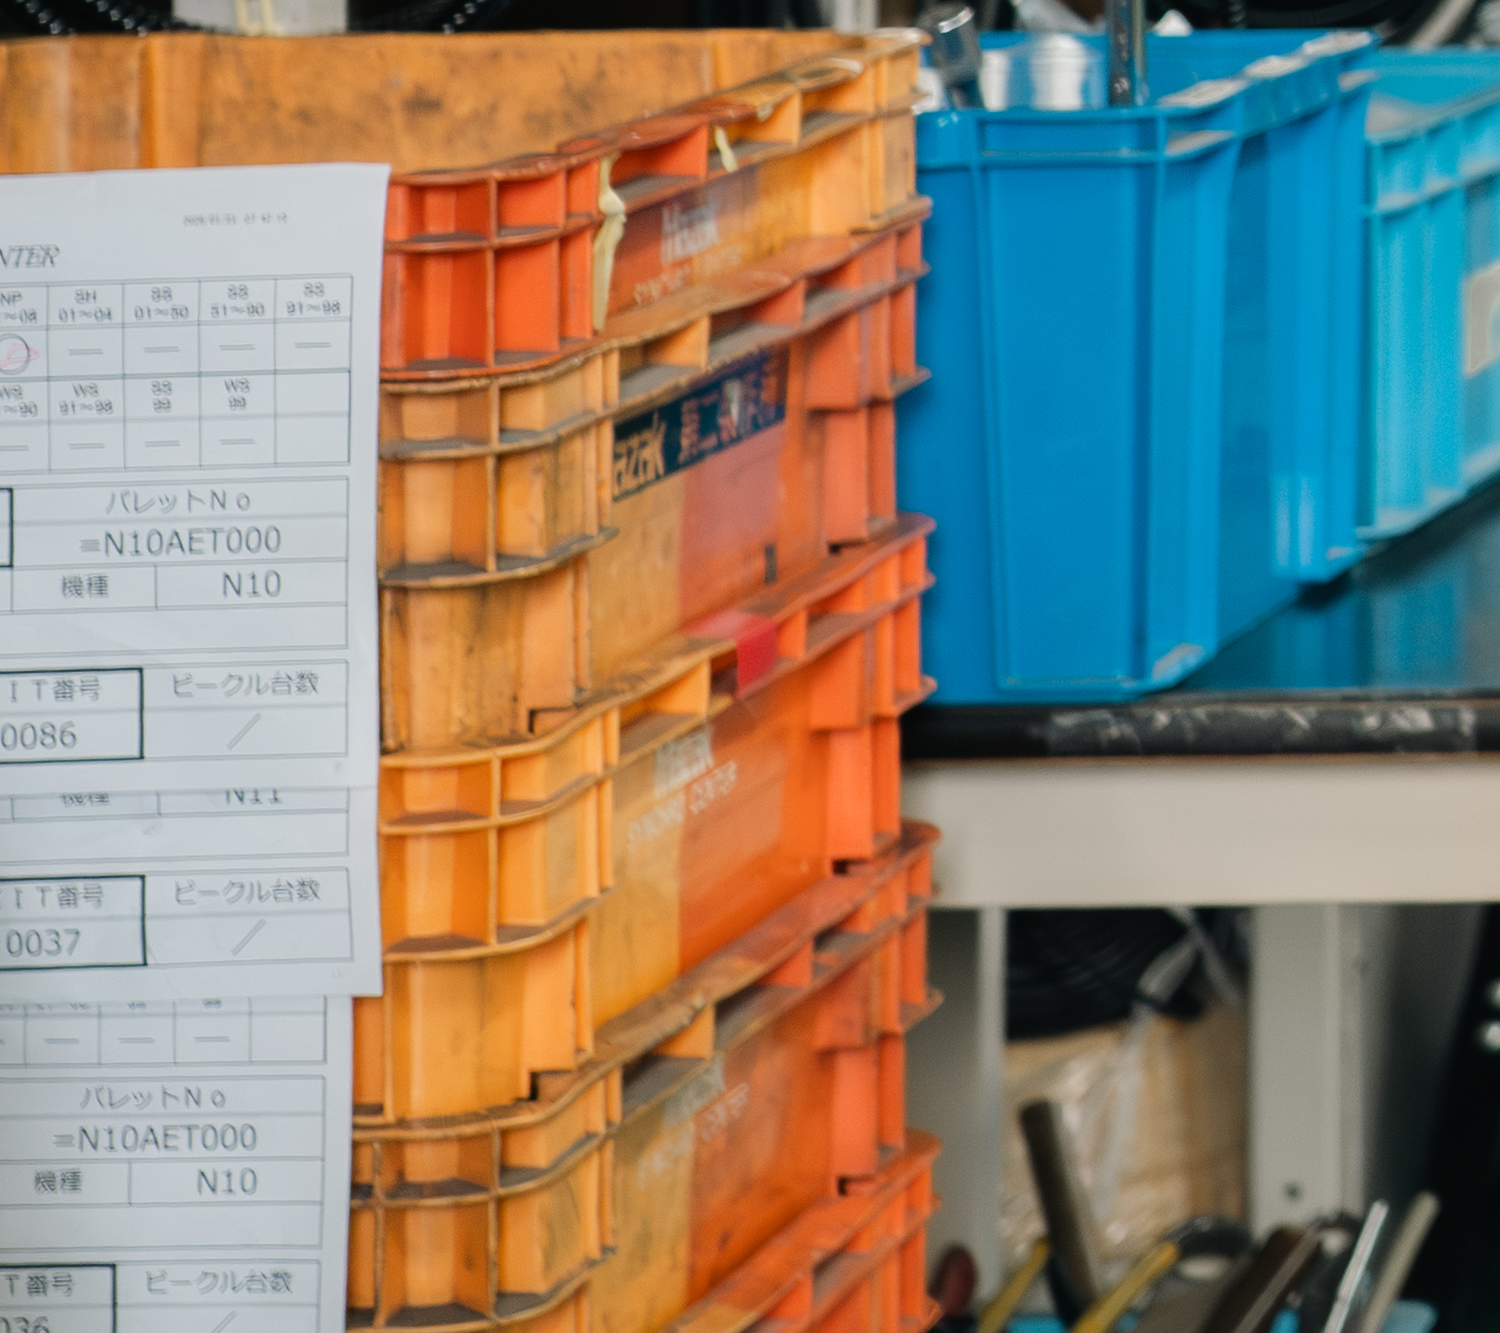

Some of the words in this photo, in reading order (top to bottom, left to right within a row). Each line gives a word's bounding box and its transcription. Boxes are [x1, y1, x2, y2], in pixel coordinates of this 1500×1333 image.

[60, 573, 110, 600] 機種
[221, 569, 282, 599] N10
[172, 670, 320, 699] ビークル台数
[0, 719, 77, 751] 0086
[173, 878, 322, 906] ビークル台数
[6, 928, 82, 958] 0037
[196, 1167, 259, 1197] N10
